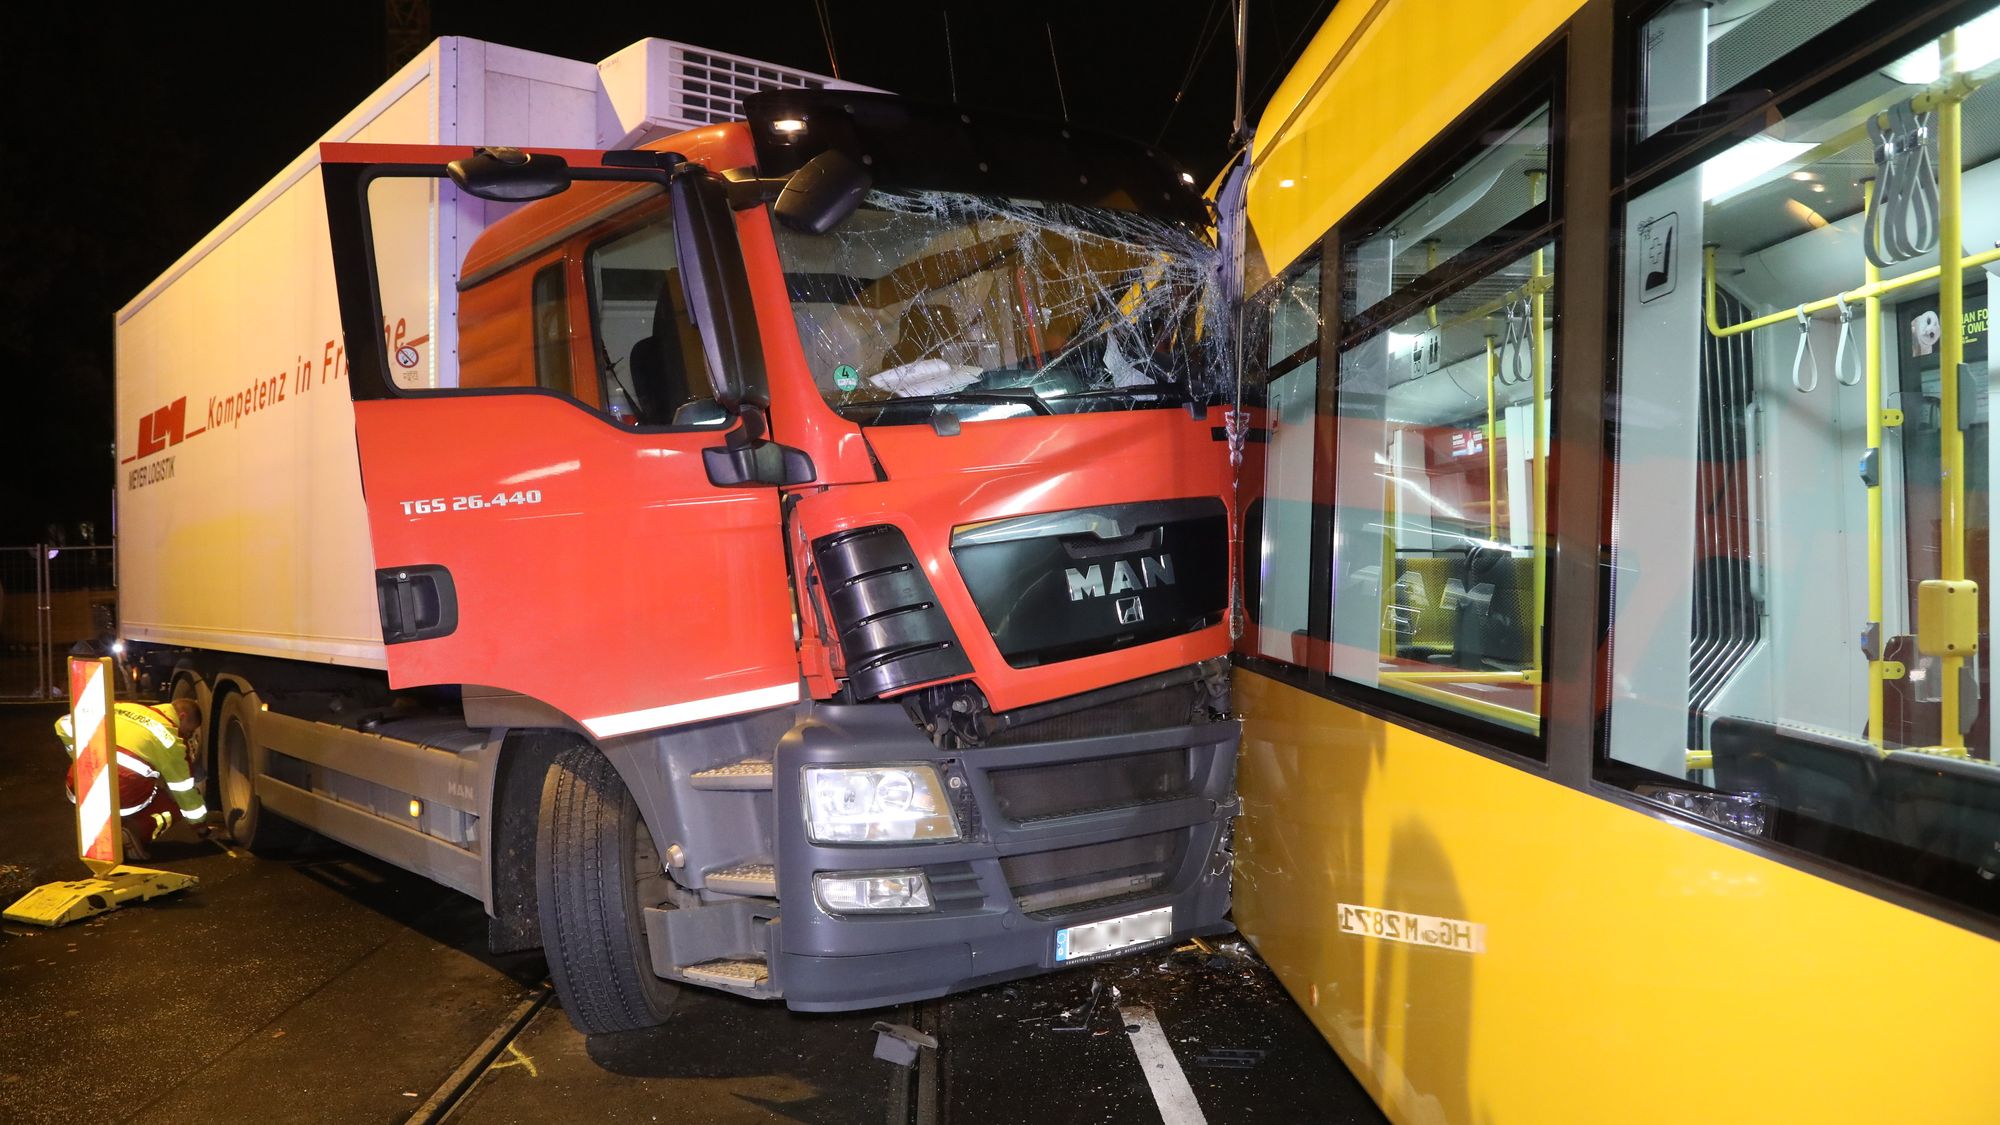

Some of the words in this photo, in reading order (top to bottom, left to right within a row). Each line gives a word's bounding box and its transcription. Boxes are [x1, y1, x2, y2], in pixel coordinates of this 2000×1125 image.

[1961, 311, 1976, 324] AN
[841, 365, 850, 379] 4
[207, 371, 287, 430] Kompetenz
[295, 354, 312, 396] in
[128, 465, 148, 491] MEYER
[148, 455, 176, 485] LOGISTIK
[400, 498, 447, 515] TGS
[452, 489, 542, 511] 26.440
[1065, 553, 1176, 602] MAN
[447, 780, 474, 800] MAN
